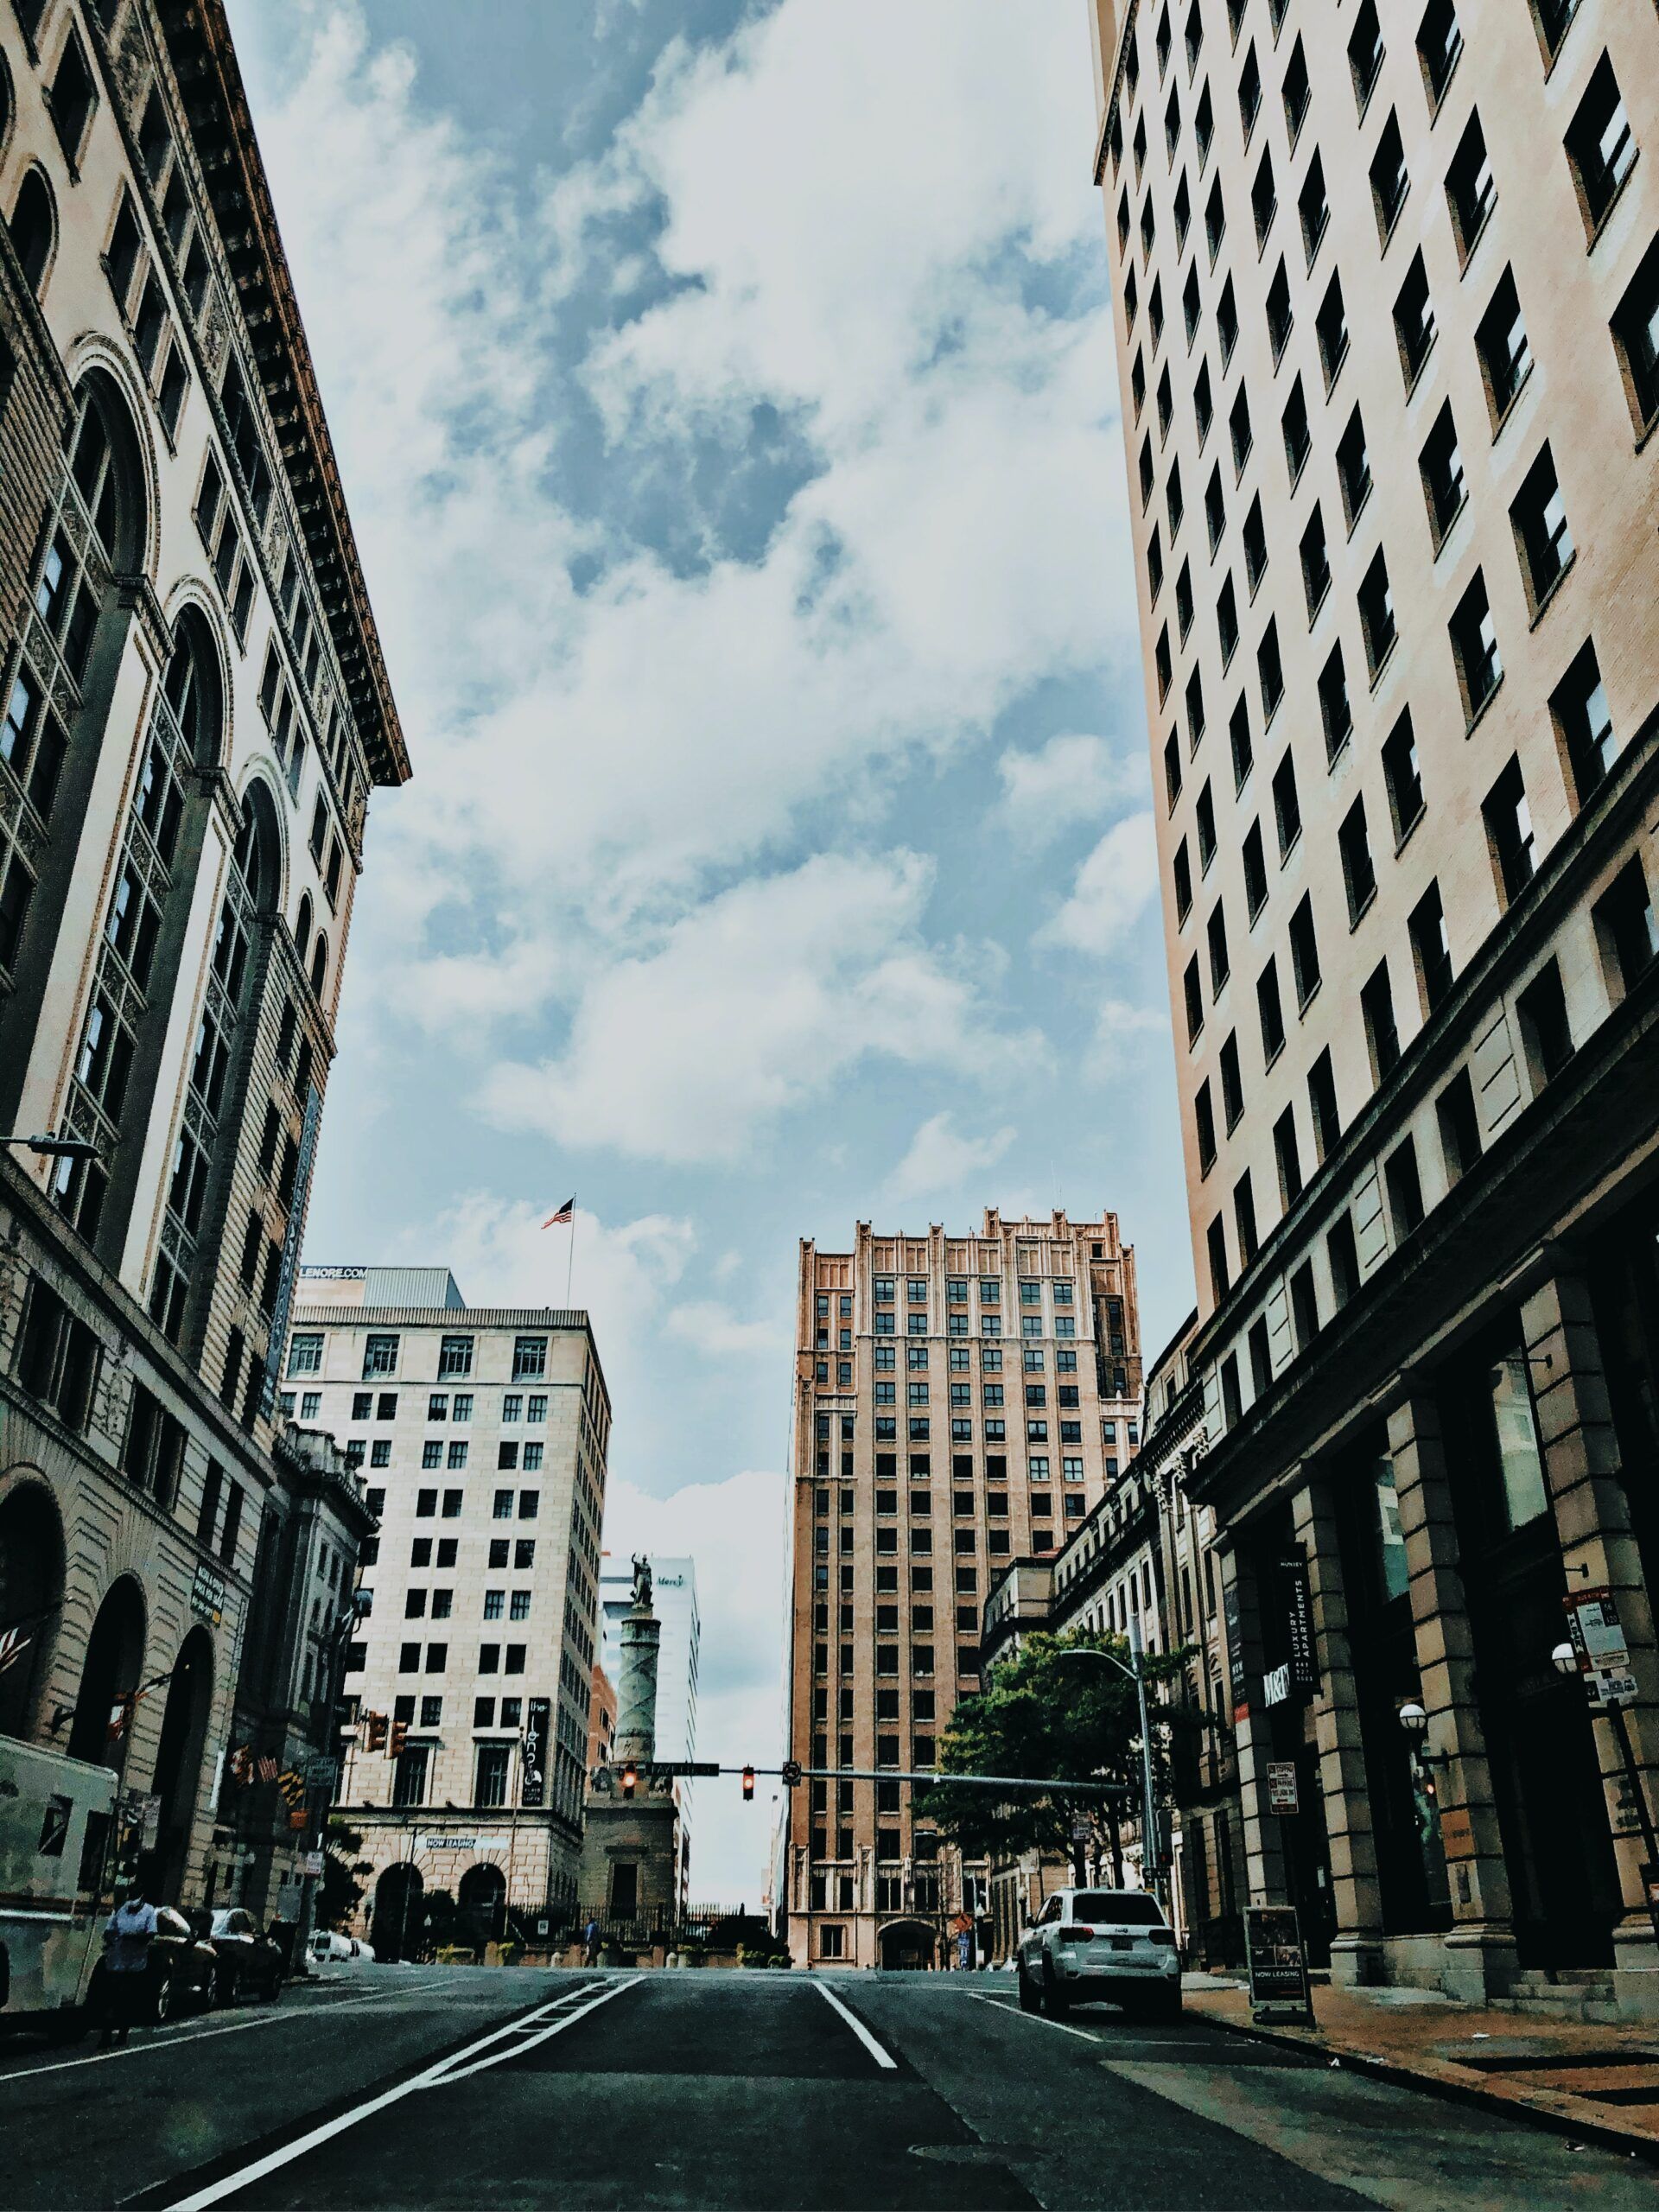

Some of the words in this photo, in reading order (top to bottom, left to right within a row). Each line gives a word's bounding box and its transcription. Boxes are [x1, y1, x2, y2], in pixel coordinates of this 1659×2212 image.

[1289, 1611, 1300, 1657] LUXURY
[1295, 1580, 1310, 1657] APARTMENTS
[427, 1839, 445, 1848] NOW
[446, 1839, 474, 1849] LEASING
